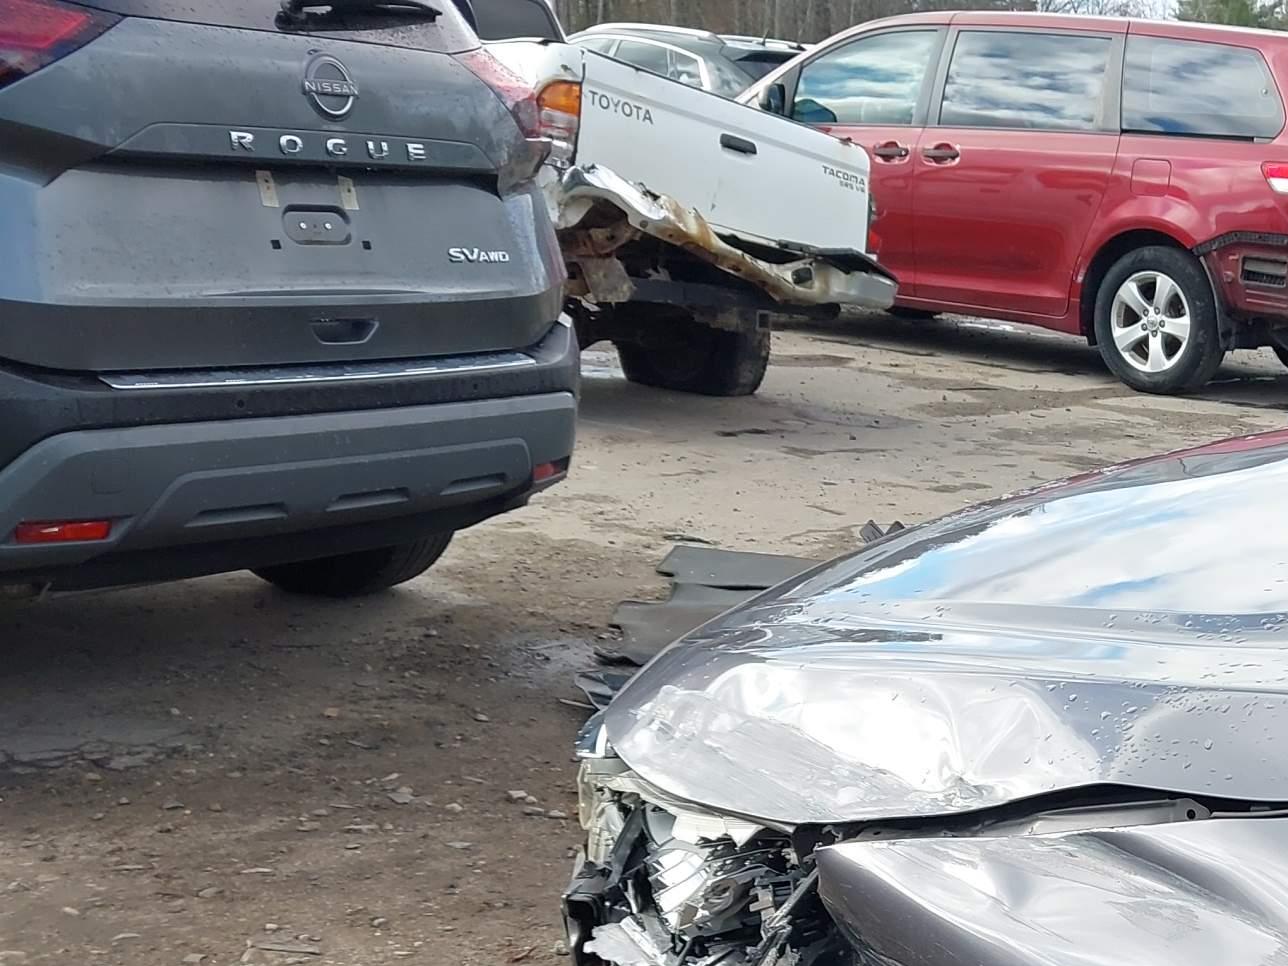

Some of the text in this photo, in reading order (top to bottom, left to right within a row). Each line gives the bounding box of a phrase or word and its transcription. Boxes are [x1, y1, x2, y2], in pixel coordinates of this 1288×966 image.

[304, 80, 358, 95] NISSAN
[588, 90, 653, 125] TOYOTA
[229, 130, 427, 161] ROGUE
[822, 164, 865, 186] TACOMA
